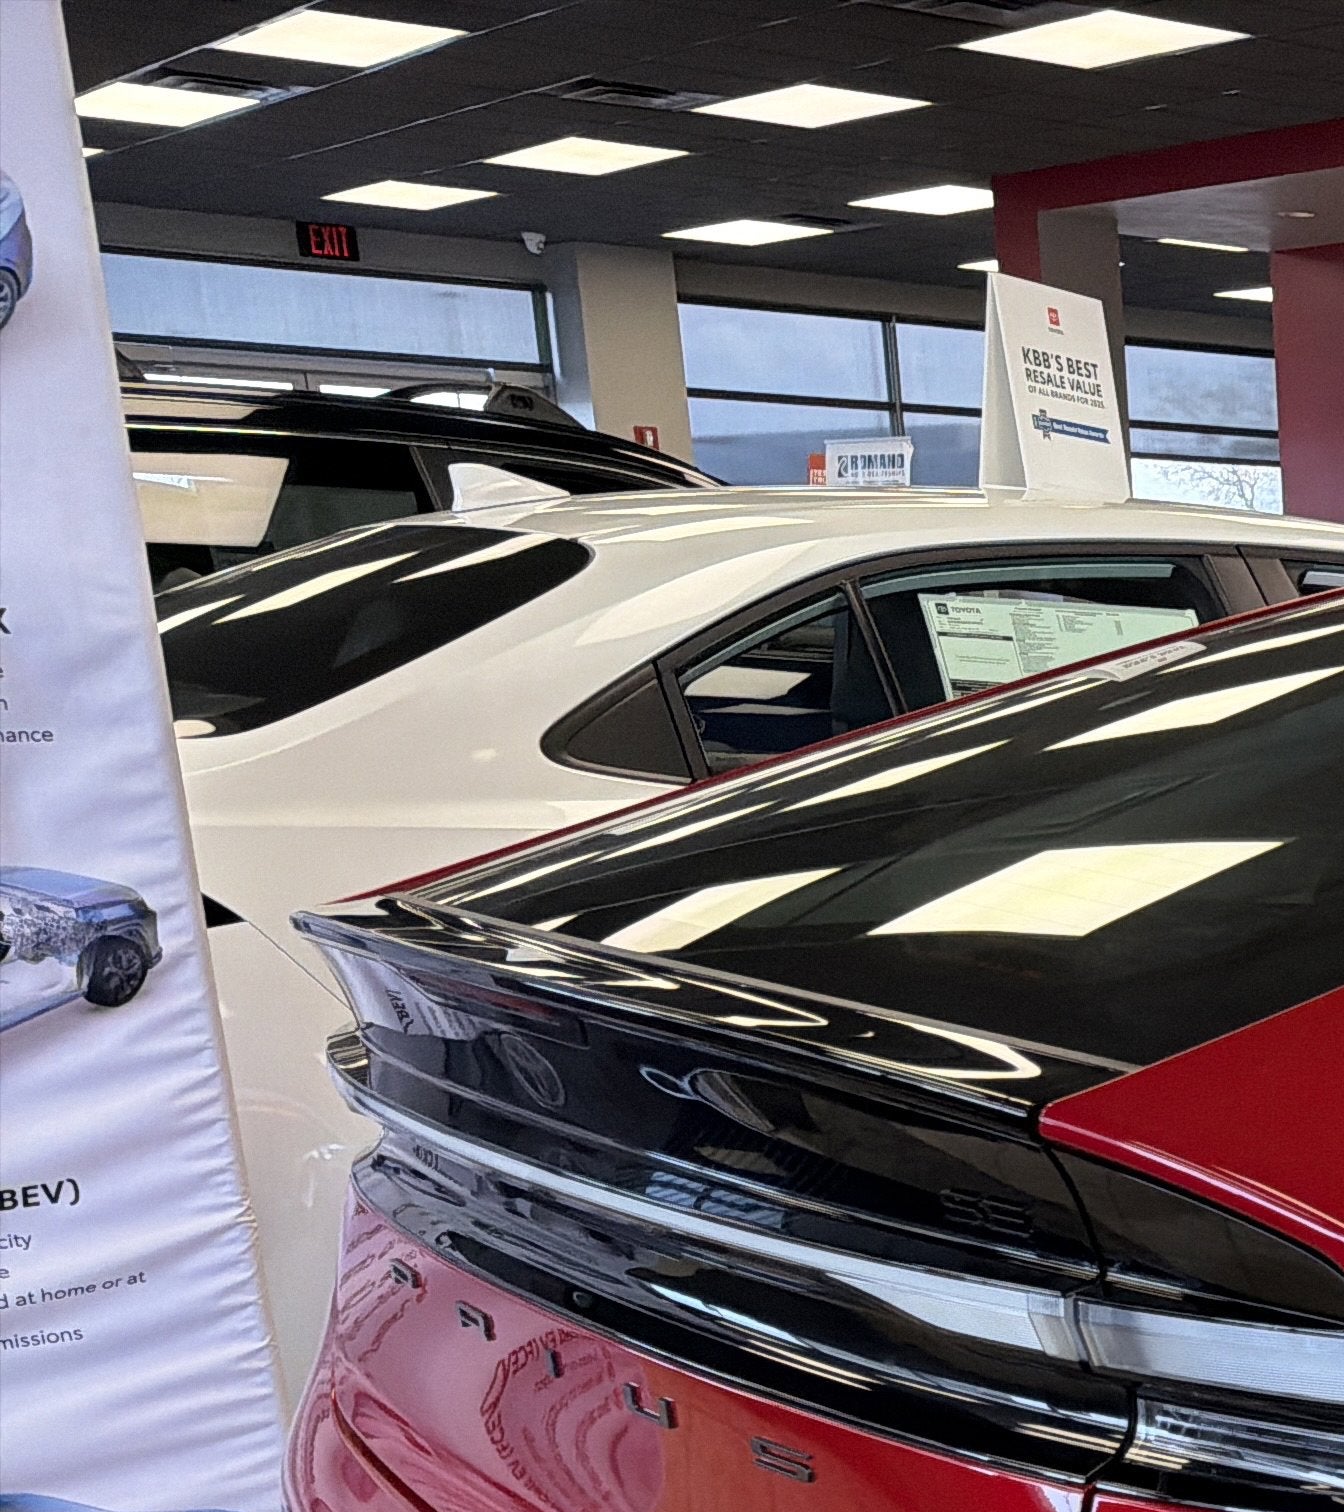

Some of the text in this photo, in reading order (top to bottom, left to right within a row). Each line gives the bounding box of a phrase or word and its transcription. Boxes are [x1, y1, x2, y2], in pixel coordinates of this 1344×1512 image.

[308, 224, 349, 257] EXIT
[1022, 346, 1099, 381] KBB'S BEST
[1025, 367, 1104, 398] RESALE VALUE
[1038, 387, 1050, 397] ALL
[1051, 389, 1076, 403] BRANDS
[1077, 396, 1089, 405] FOR
[0, 1178, 80, 1211] BEV)
[15, 1292, 37, 1307] at
[41, 1284, 97, 1303] home
[102, 1278, 122, 1290] or
[127, 1271, 147, 1286] at
[390, 1257, 816, 1484] PRIUS
